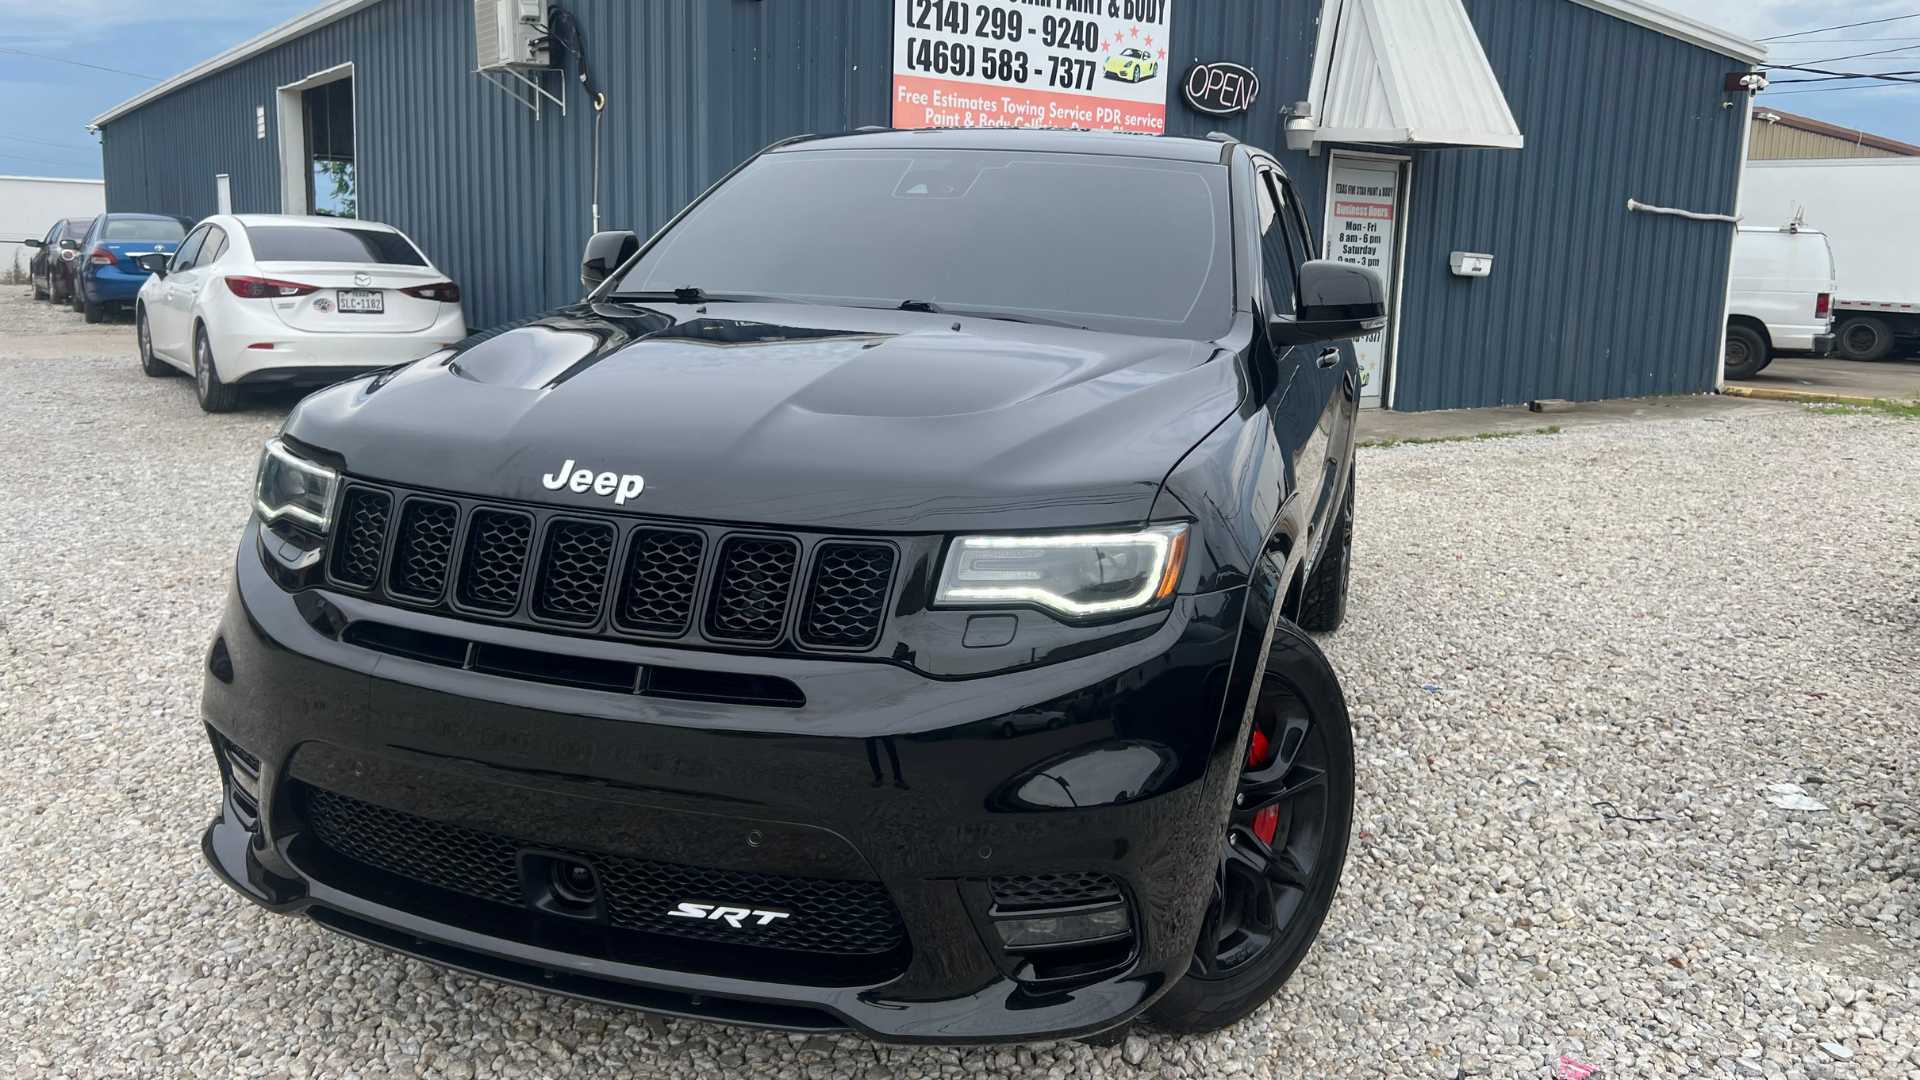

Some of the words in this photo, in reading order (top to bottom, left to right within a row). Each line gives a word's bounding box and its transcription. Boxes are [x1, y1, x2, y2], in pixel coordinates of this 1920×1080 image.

[906, 0, 969, 34] (214)
[975, 5, 1023, 42] 299
[1042, 15, 1099, 53] 9240
[907, 37, 976, 77] (469)
[982, 47, 1029, 83] 583
[1048, 55, 1097, 91] 7377
[1189, 64, 1254, 111] OPEN
[898, 85, 929, 105] Free
[933, 89, 998, 112] Estimates
[1001, 97, 1045, 119] Towing
[1050, 102, 1093, 122] Service
[1096, 107, 1121, 124] PDR
[1125, 113, 1163, 128] service
[925, 107, 960, 127] Paint
[963, 111, 974, 127] &
[1346, 221, 1361, 231] Mon
[1367, 222, 1377, 232] Fri
[1346, 234, 1357, 242] am
[1363, 233, 1368, 243] 6
[1369, 236, 1381, 244] pm
[1342, 245, 1376, 256] Saturday
[1361, 257, 1366, 265] 3
[1368, 258, 1379, 267] pm
[542, 459, 645, 505] Jeep
[667, 902, 790, 928] SRT
